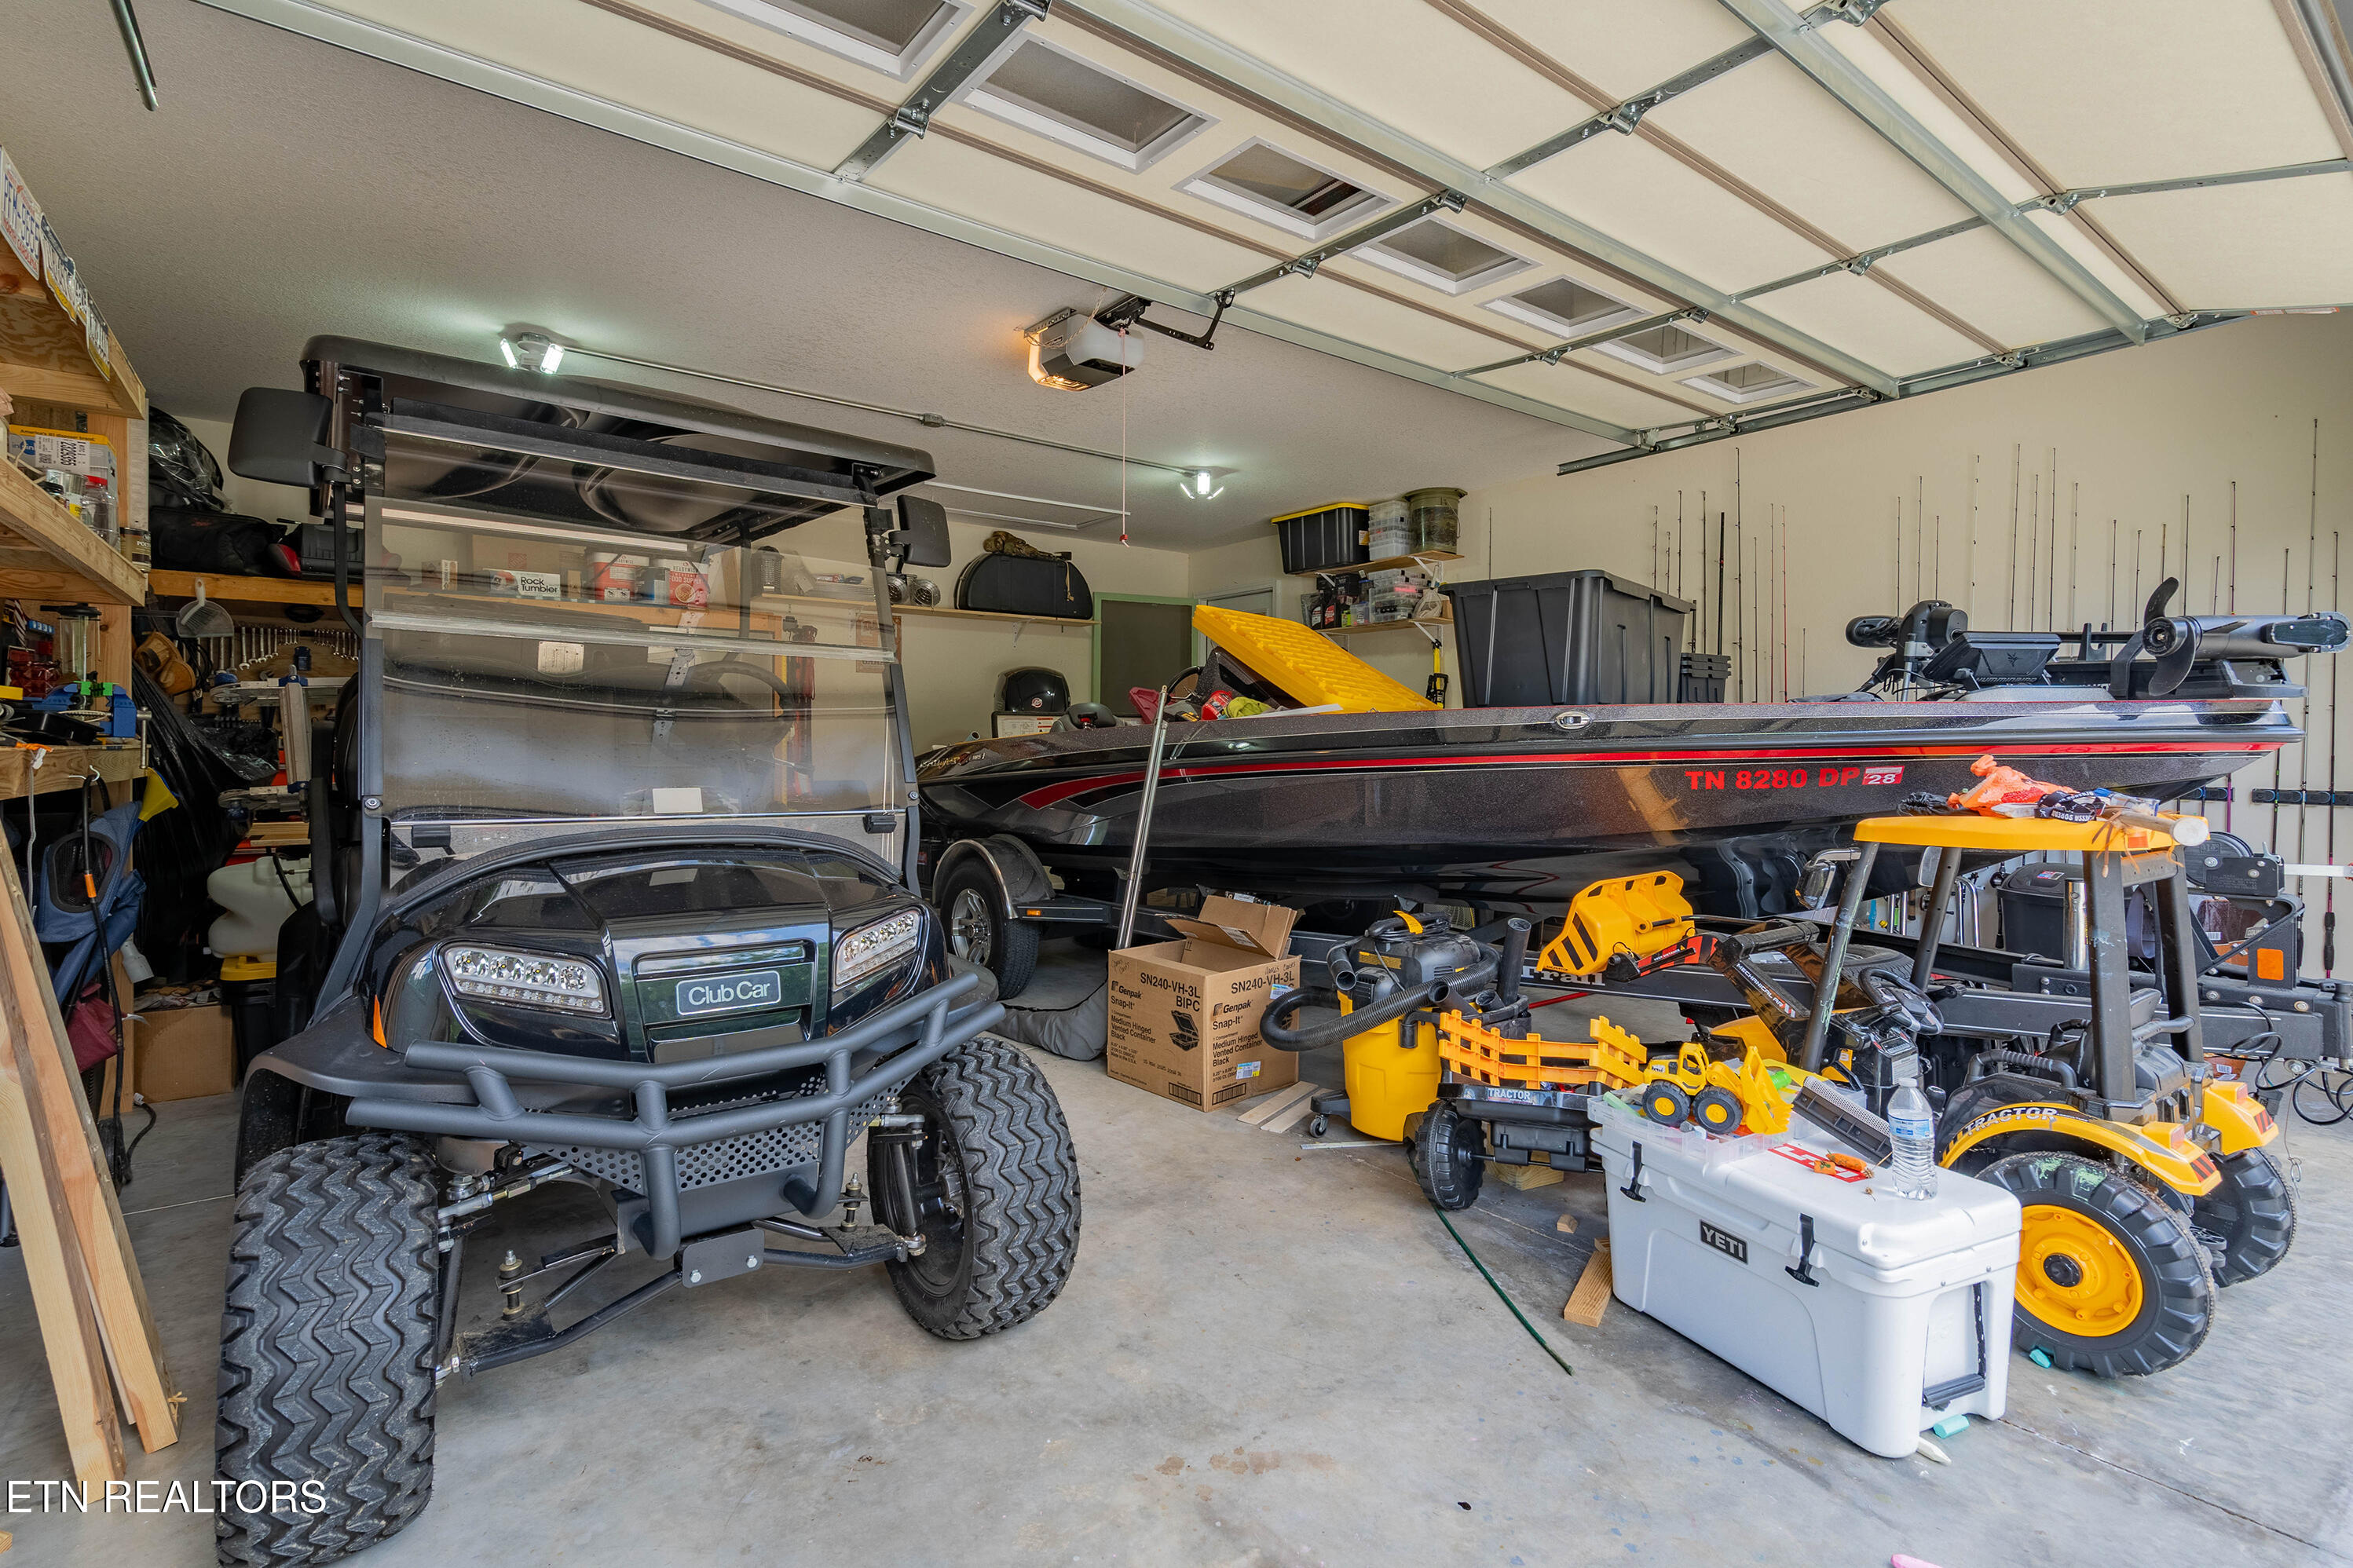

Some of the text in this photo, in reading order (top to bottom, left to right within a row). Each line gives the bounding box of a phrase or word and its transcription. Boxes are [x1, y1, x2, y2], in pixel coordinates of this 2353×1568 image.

[520, 576, 545, 586] Rock
[521, 584, 559, 594] Tumbler
[1685, 767, 1861, 790] TN 8280 DP
[1868, 774, 1895, 784] 28
[1140, 972, 1201, 999] SN240-VH-3L
[1231, 970, 1294, 994] SN240-VH-3L
[1736, 963, 1773, 1000] MECHANICAL
[689, 981, 770, 1006] Club Car
[1118, 985, 1141, 1000] Genpak
[1111, 996, 1133, 1010] Snap-It
[1176, 996, 1201, 1012] BIPC
[1223, 999, 1251, 1013] Genpak
[1111, 1015, 1151, 1035] Medium Hinged
[1213, 1016, 1240, 1030] Snap-It
[1111, 1022, 1156, 1044] Vented Container
[1111, 1030, 1125, 1041] Black
[1213, 1032, 1258, 1051] Medium Hinged
[1213, 1040, 1263, 1058] Vented Container
[1213, 1056, 1230, 1067] Black
[1488, 1087, 1531, 1100] TRACTOR
[1965, 1107, 2058, 1135] TRACTOR
[1702, 1226, 1744, 1259] YETI
